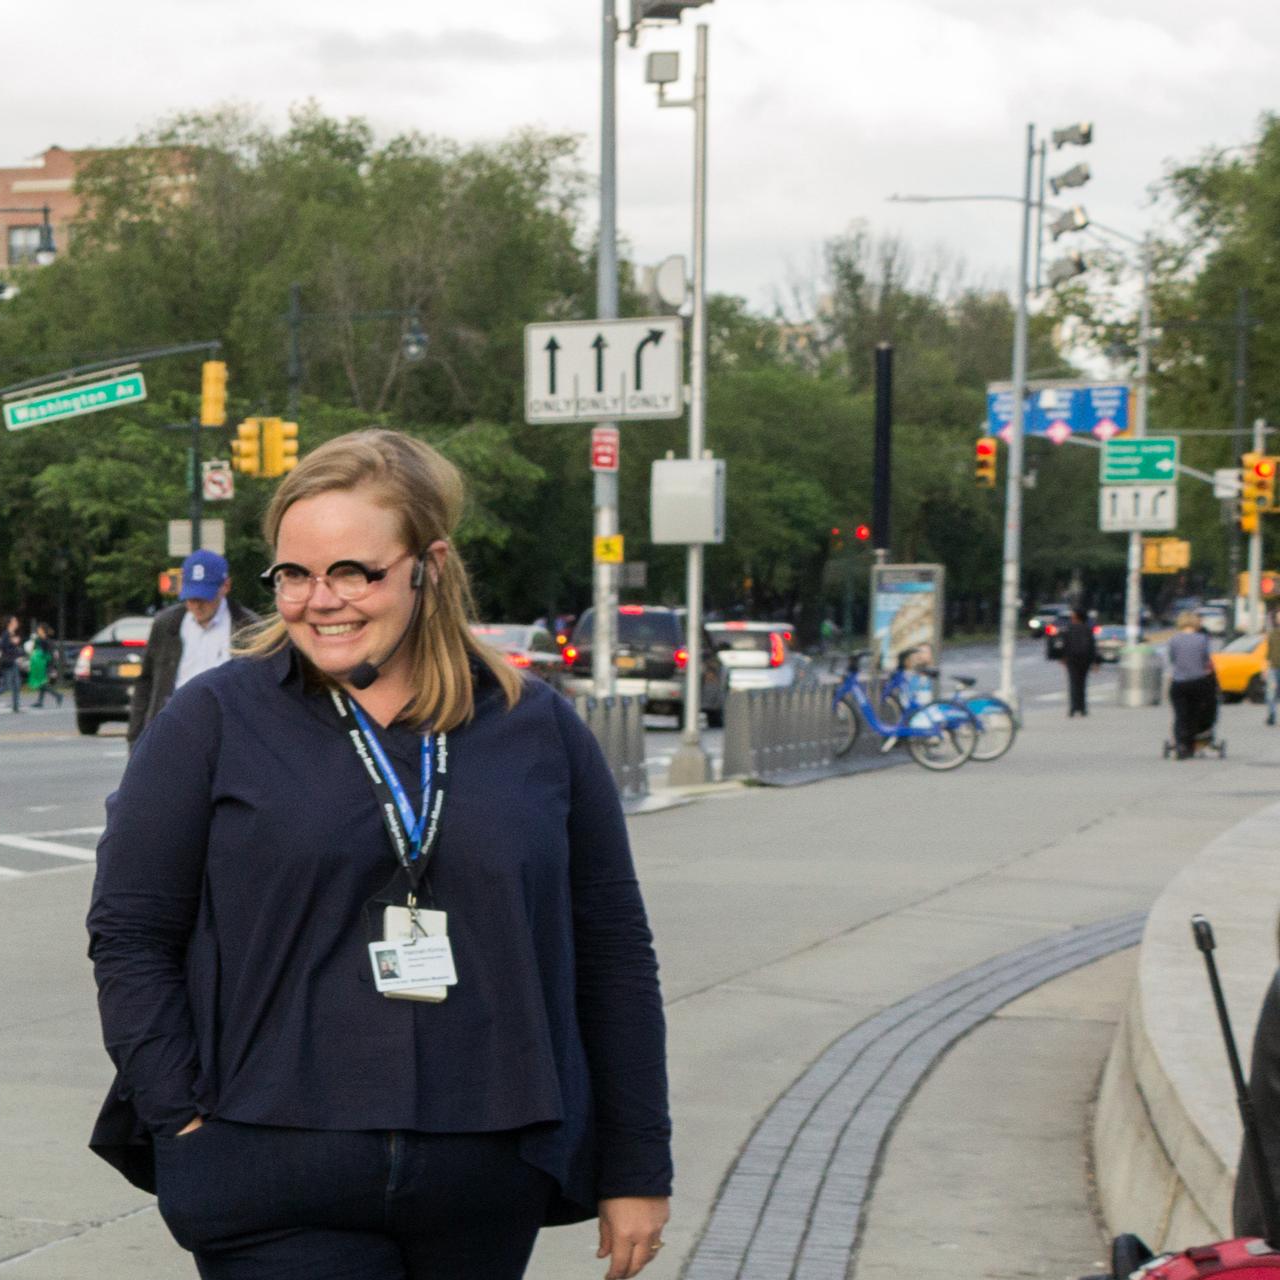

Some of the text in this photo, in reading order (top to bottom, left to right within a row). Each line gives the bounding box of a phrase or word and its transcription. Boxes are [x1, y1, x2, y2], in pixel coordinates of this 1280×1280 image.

[15, 384, 135, 421] Washington Av
[530, 399, 571, 413] ONLY
[578, 398, 618, 411] ONLY
[627, 394, 670, 408] ONLY
[349, 729, 369, 759] Brooklyn
[364, 757, 383, 784] Museum
[384, 803, 401, 839] Brooklyn
[421, 819, 438, 854] Brooklyn
[431, 789, 445, 820] Museum
